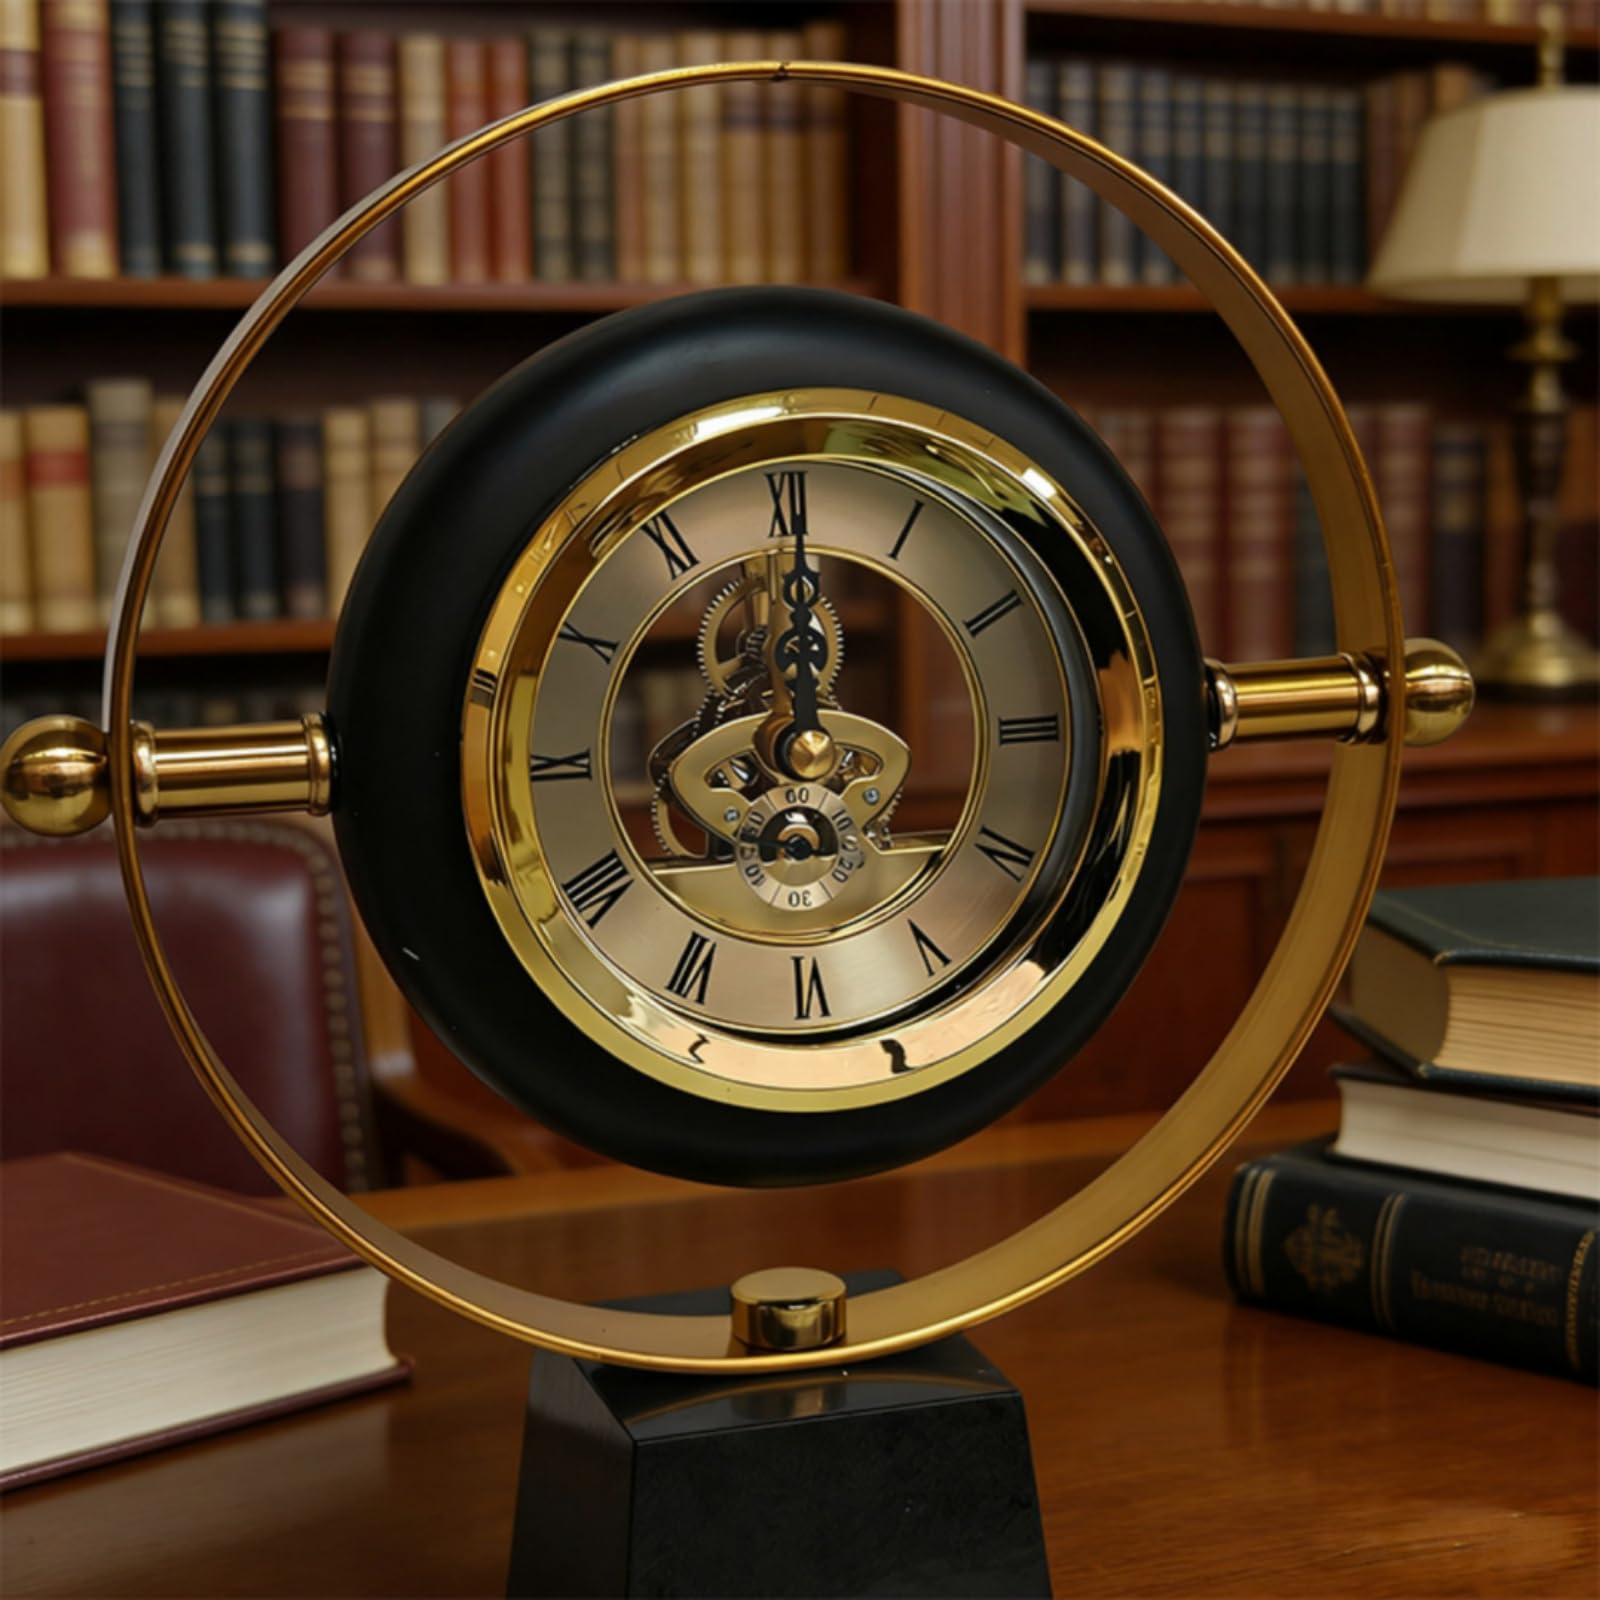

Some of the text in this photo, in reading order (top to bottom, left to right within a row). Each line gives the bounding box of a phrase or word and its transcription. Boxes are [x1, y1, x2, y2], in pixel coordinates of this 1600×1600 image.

[764, 471, 809, 537] XII
[888, 501, 925, 560] I
[639, 510, 700, 582] XI
[963, 589, 1023, 638] II
[557, 621, 620, 664] X
[997, 713, 1060, 745] III
[530, 749, 592, 782] IX
[832, 809, 853, 831] 10
[975, 827, 1036, 883] IV
[561, 848, 635, 928] VIII
[787, 891, 812, 907] 30
[665, 931, 718, 1005] VII
[908, 919, 953, 979] V
[791, 956, 831, 1020] VI
